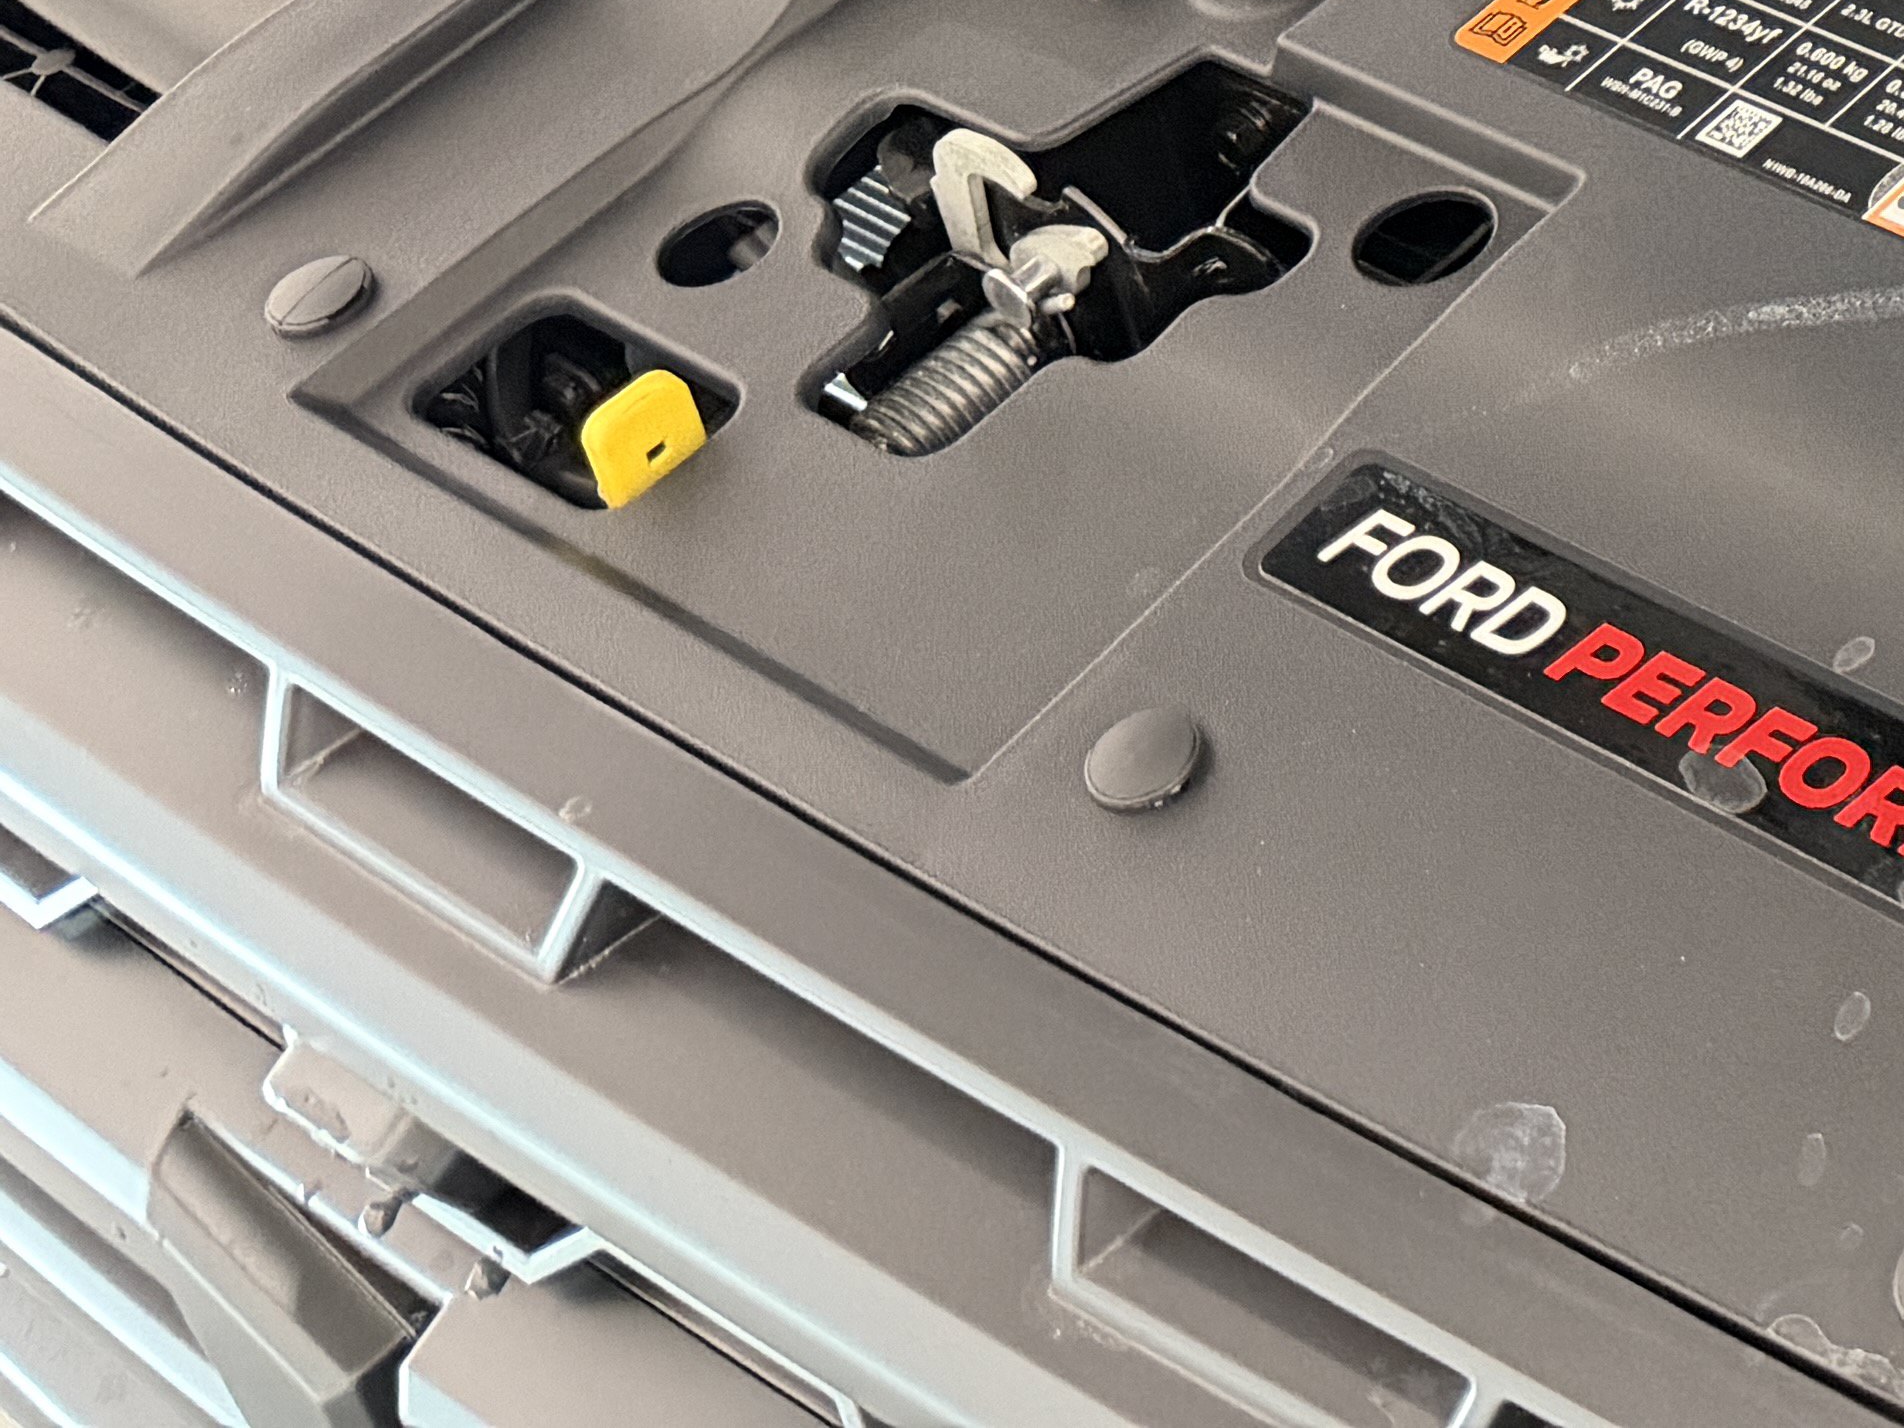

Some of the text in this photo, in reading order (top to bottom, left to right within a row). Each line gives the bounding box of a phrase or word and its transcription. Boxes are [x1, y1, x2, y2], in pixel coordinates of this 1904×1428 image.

[1840, 3, 1872, 27] 2.3L
[1679, 38, 1745, 74] (GWP 4)
[1795, 40, 1869, 84] 0.600 kg
[1628, 67, 1684, 101] PAG
[1798, 86, 1824, 107] lbs
[1820, 77, 1842, 93] oz
[1316, 509, 1569, 657] FORD
